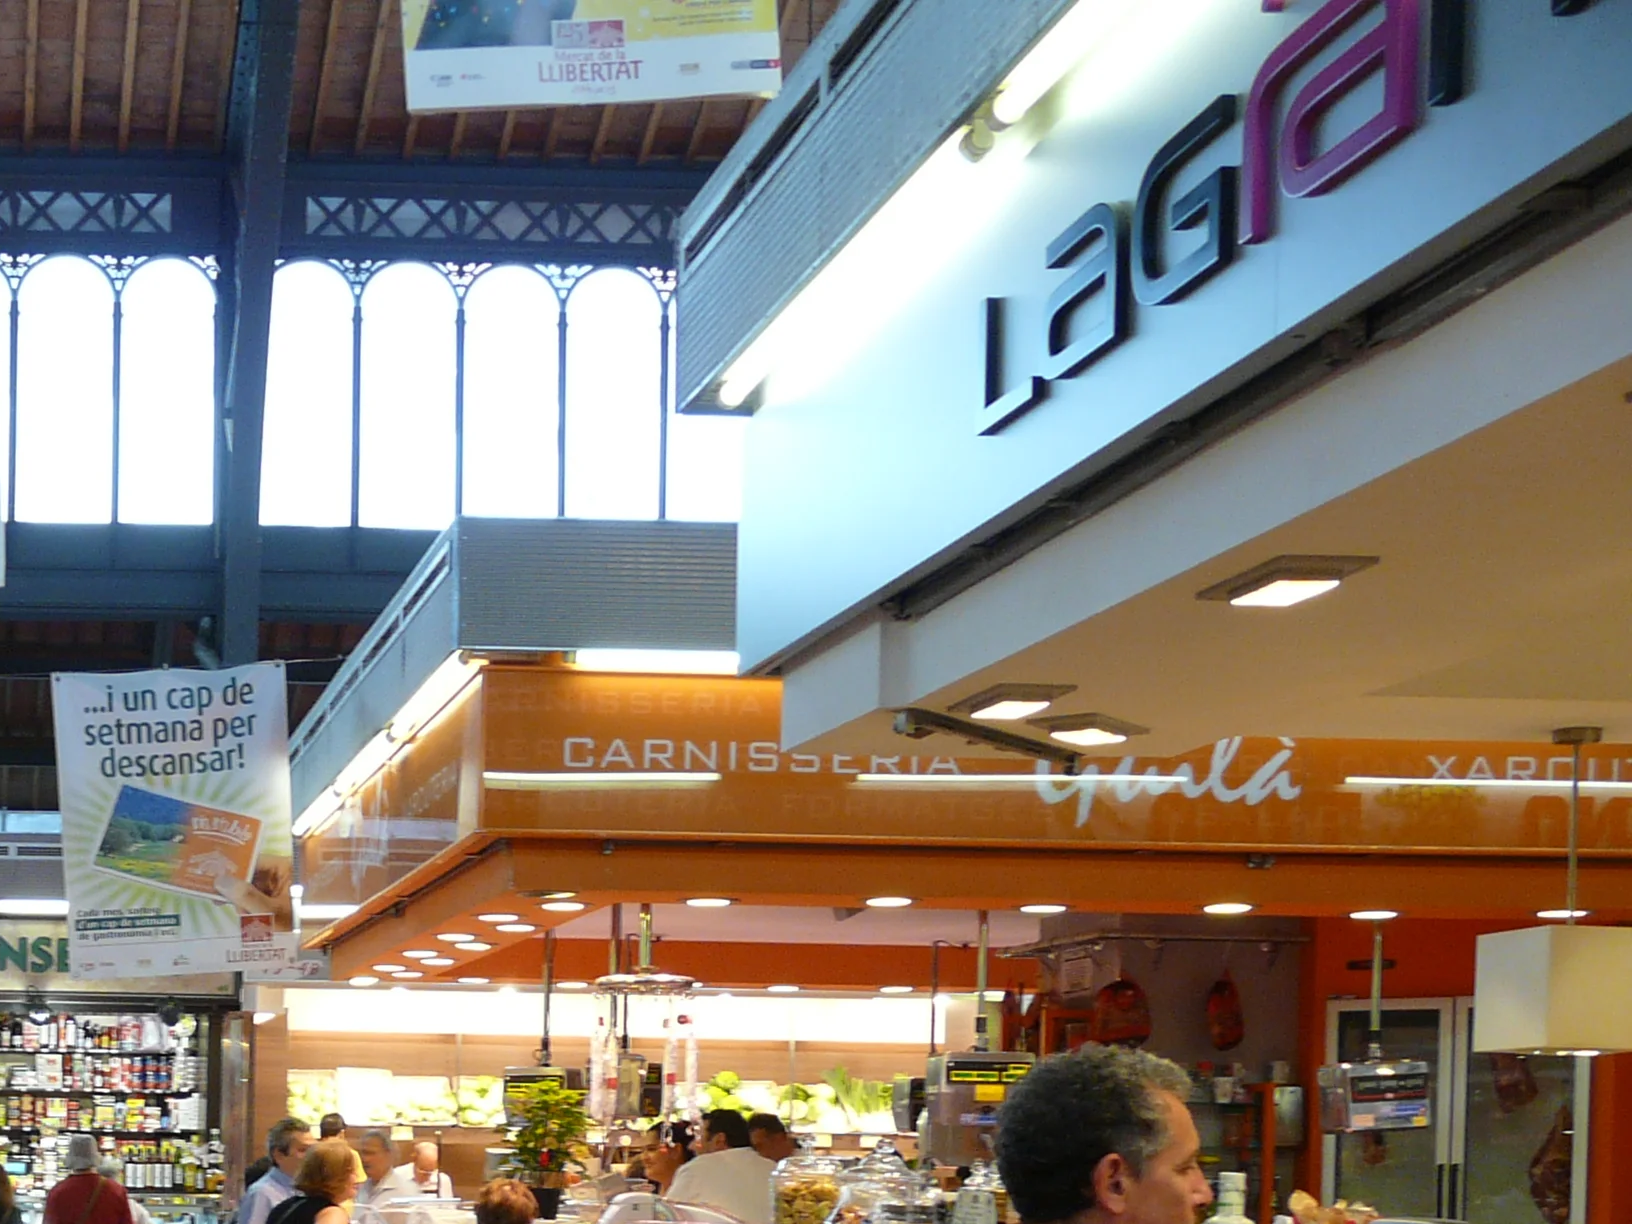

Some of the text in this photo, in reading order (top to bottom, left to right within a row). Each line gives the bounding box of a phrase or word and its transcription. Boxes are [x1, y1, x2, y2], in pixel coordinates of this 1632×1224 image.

[537, 60, 644, 83] LLIBERTAT
[123, 687, 157, 712] un
[167, 684, 213, 716] cap
[223, 676, 254, 706] de
[84, 713, 257, 748] setmana per
[100, 742, 245, 779] descansar!
[1427, 754, 1632, 782] XARCU
[225, 948, 287, 963] LLIBERTAT
